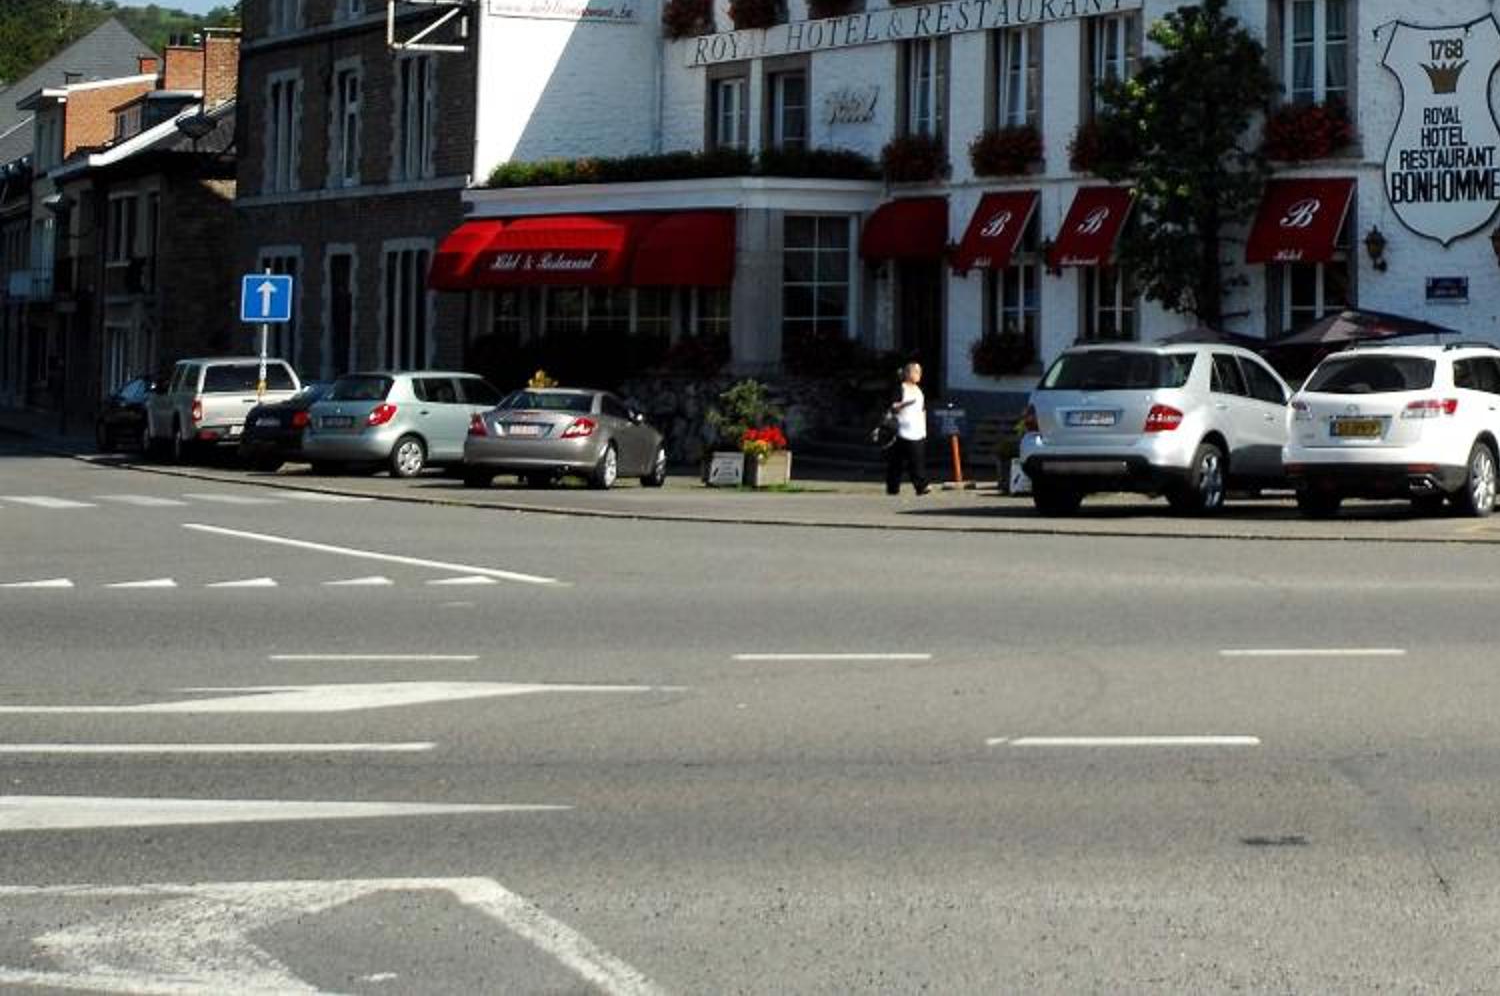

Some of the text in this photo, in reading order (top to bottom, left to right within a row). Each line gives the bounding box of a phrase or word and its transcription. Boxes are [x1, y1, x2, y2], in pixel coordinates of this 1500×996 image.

[786, 13, 879, 51] HOTEL
[886, 10, 904, 39] &
[1430, 39, 1464, 61] 1768
[1423, 107, 1461, 125] ROYAL
[1421, 126, 1468, 148] HOTEL
[1400, 146, 1496, 171] RESTAURANT
